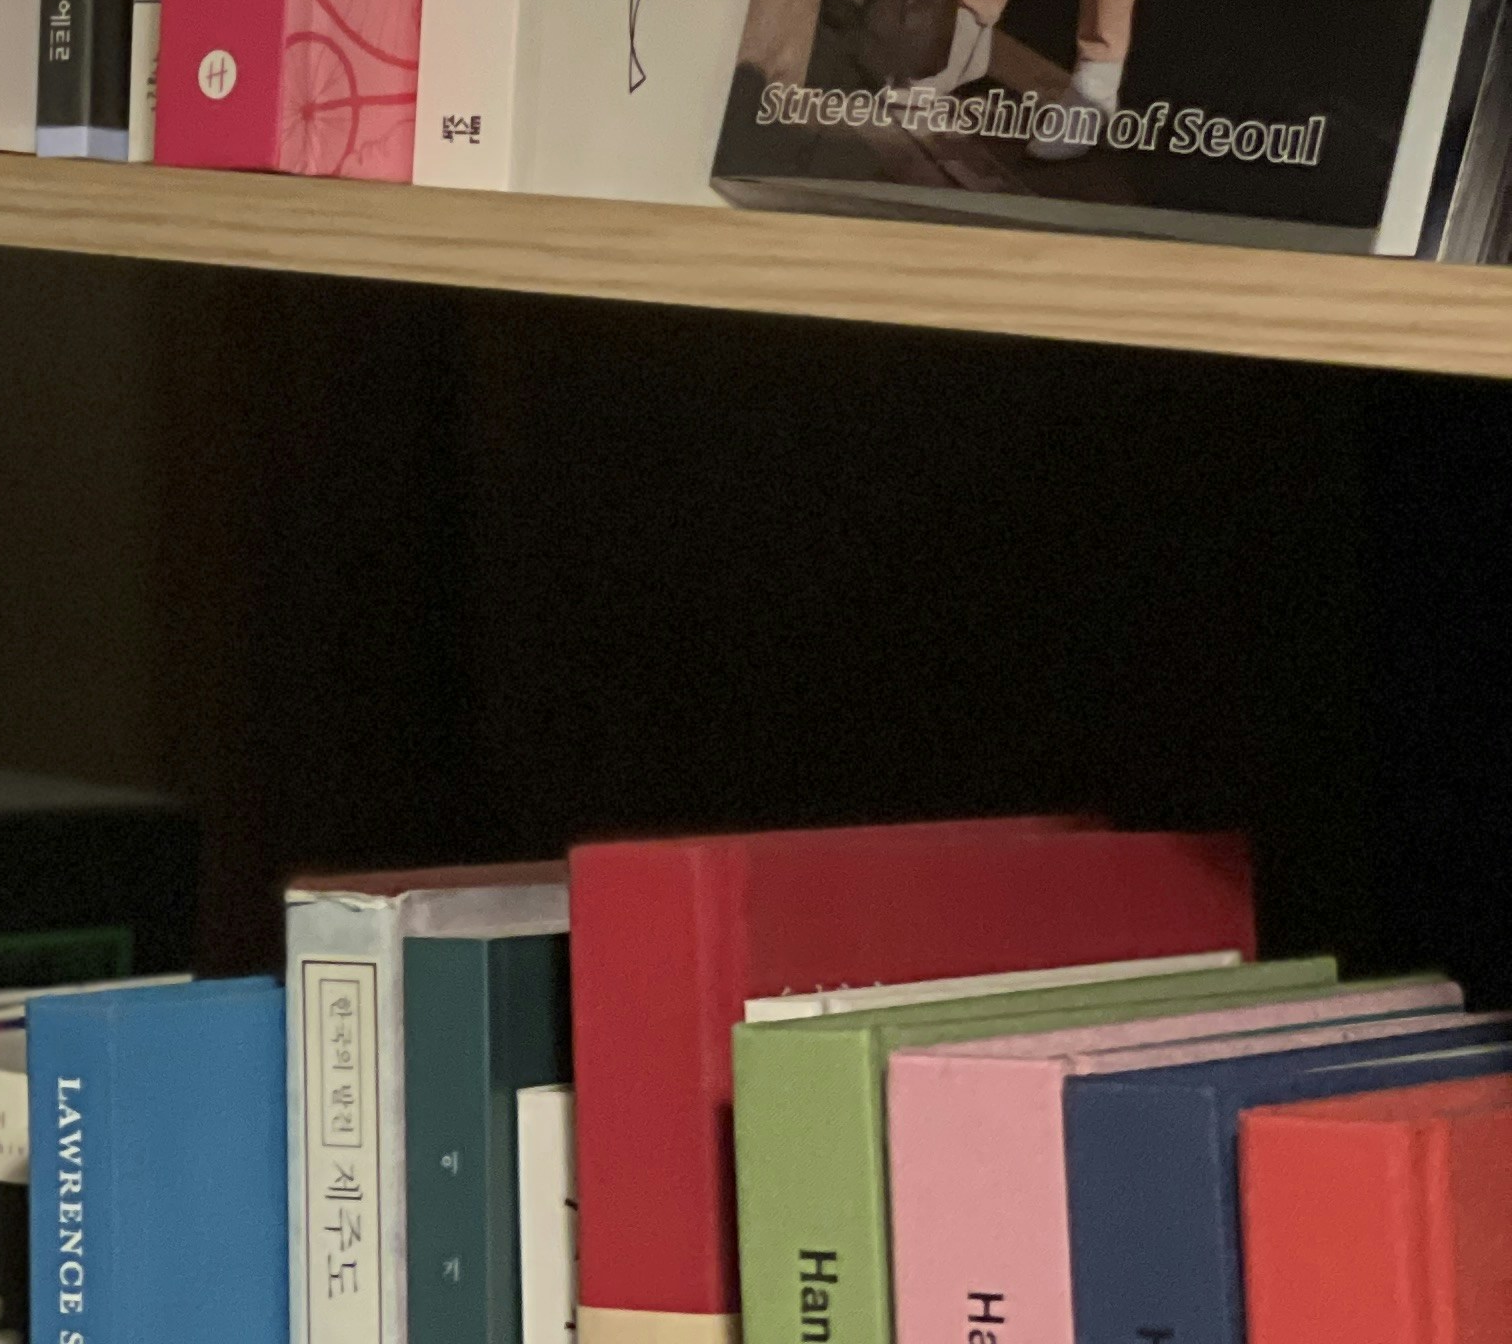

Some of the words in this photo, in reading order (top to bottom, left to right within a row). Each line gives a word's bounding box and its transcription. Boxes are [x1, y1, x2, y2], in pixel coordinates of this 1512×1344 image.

[755, 81, 896, 128] Street
[904, 85, 1104, 147] Fashion
[1109, 100, 1163, 153] of
[1168, 108, 1327, 167] Seoul
[330, 995, 353, 1072] 한국의
[330, 1083, 356, 1133] 발견
[57, 1075, 85, 1314] LAWRENCE
[324, 1161, 364, 1300] 제주도
[799, 1249, 838, 1344] Han
